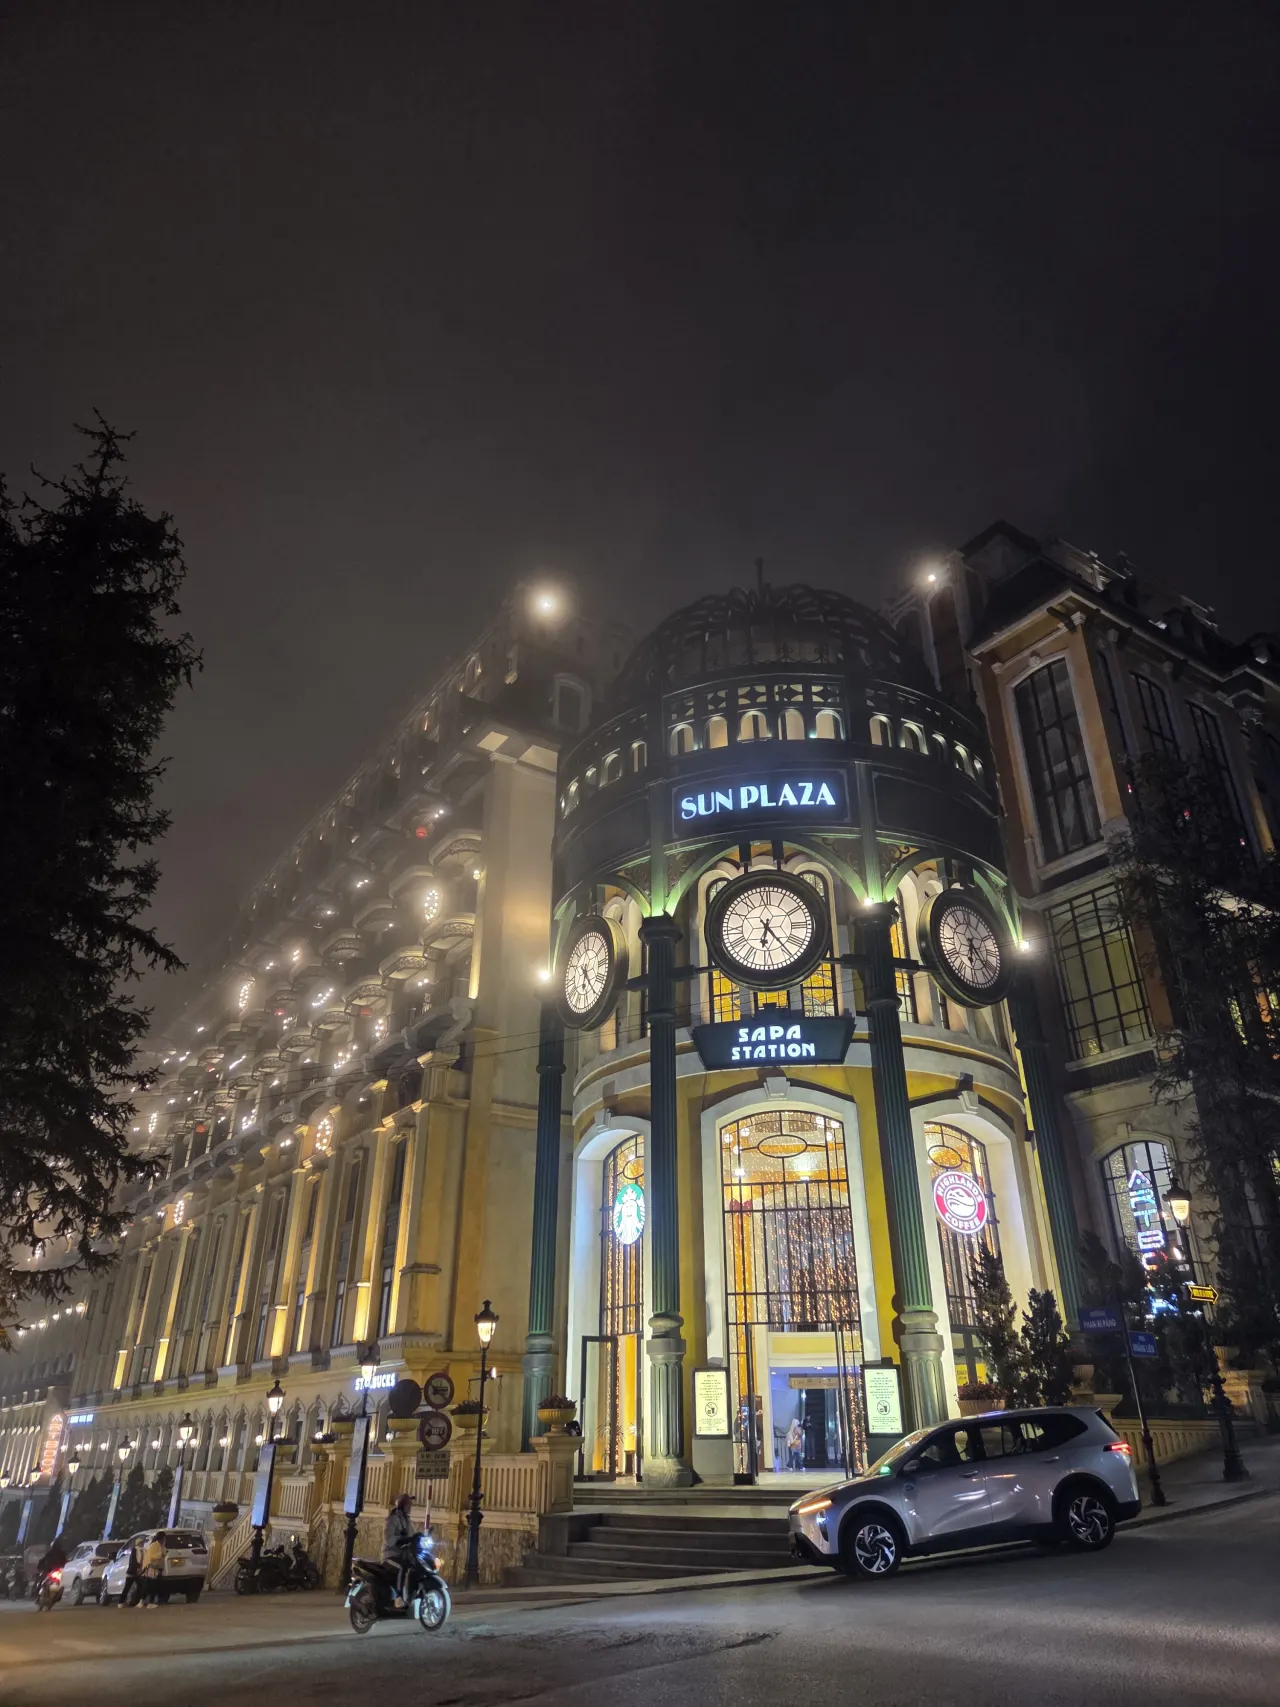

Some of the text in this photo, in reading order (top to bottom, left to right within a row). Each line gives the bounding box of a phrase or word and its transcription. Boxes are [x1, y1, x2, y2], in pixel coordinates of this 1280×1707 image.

[680, 782, 836, 820] SUN PLAZA
[738, 1025, 802, 1043] SAPA
[731, 1043, 816, 1061] STATION
[937, 1175, 983, 1202] HIGHLANDS
[944, 1212, 981, 1230] COFFEE
